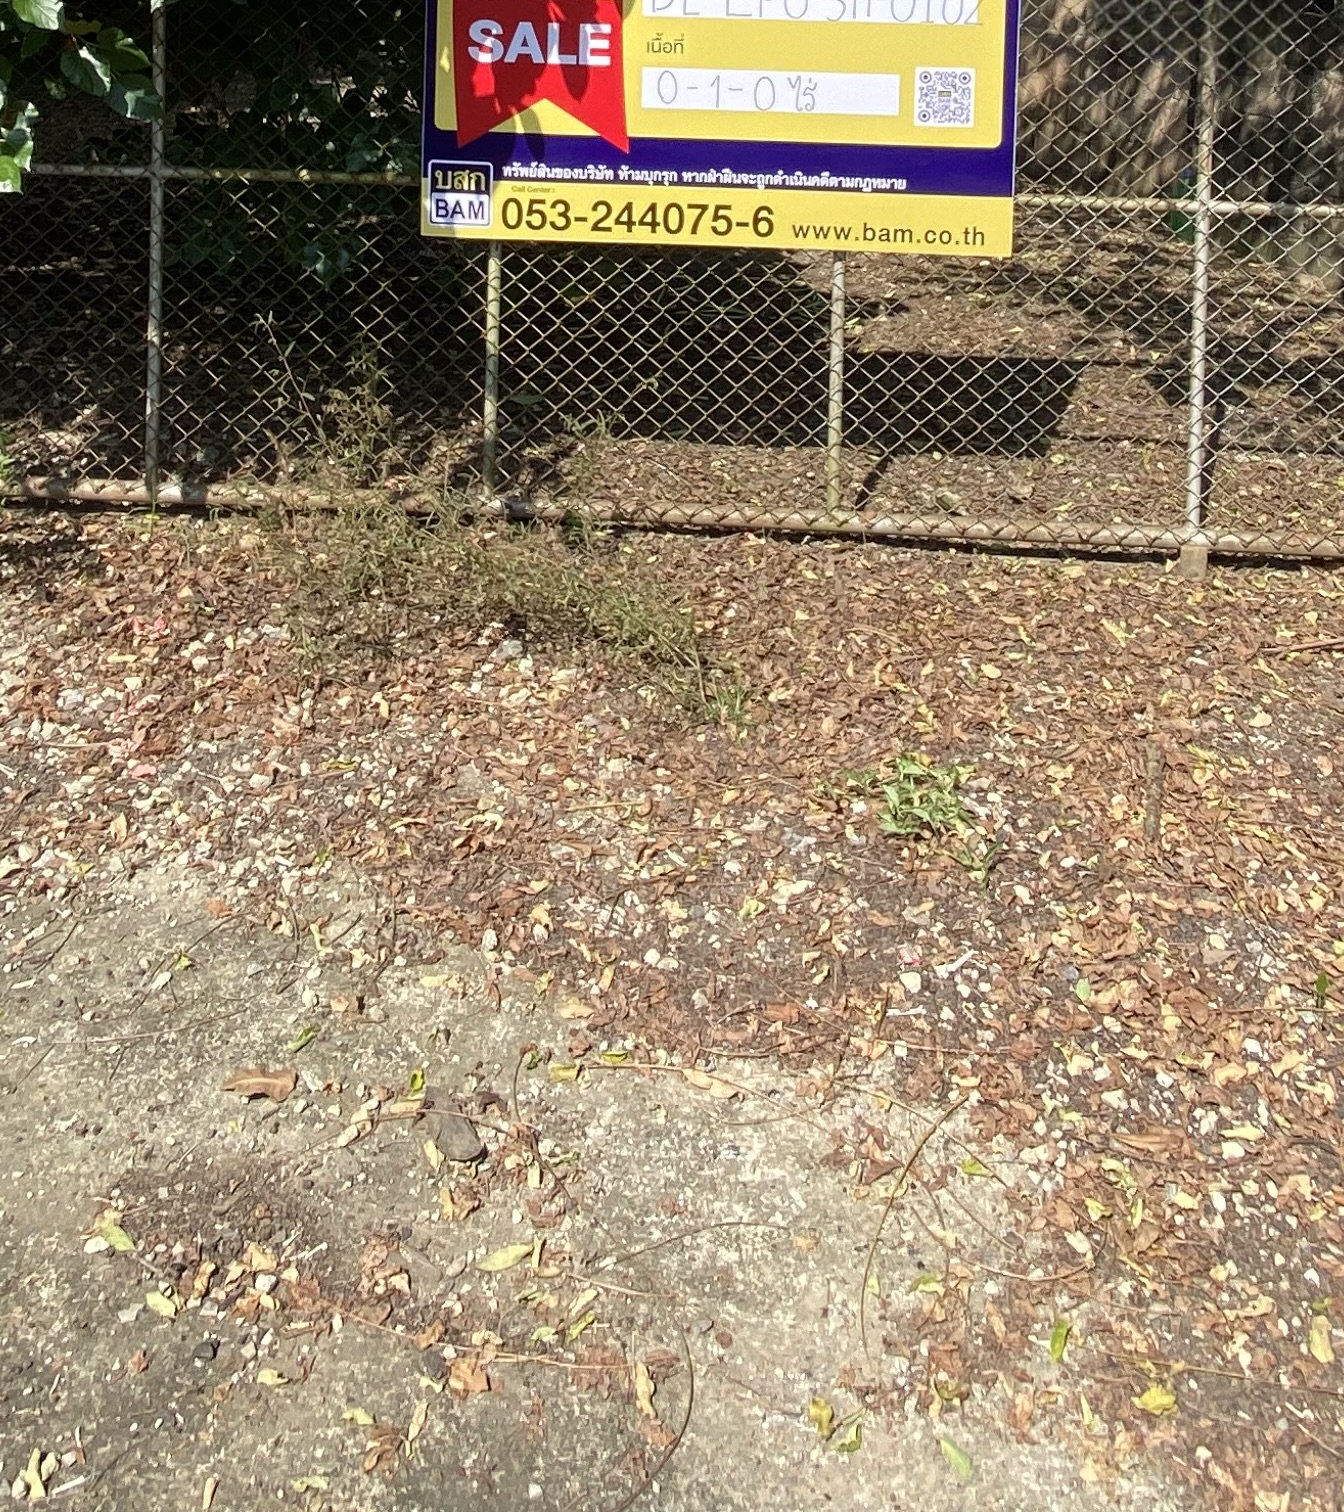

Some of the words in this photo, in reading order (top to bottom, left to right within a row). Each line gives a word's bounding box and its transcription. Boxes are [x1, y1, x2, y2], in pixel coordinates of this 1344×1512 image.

[467, 19, 613, 67] SALE
[646, 32, 685, 55] เนื้อที่
[434, 167, 486, 191] บสก
[501, 162, 615, 181] ทรัพย์สินของบริษัท
[618, 164, 678, 186] ห้ามบุกรุก
[434, 199, 486, 220] BAM
[501, 197, 775, 238] 053-244075-6
[792, 222, 985, 246] www.bam.co.th
